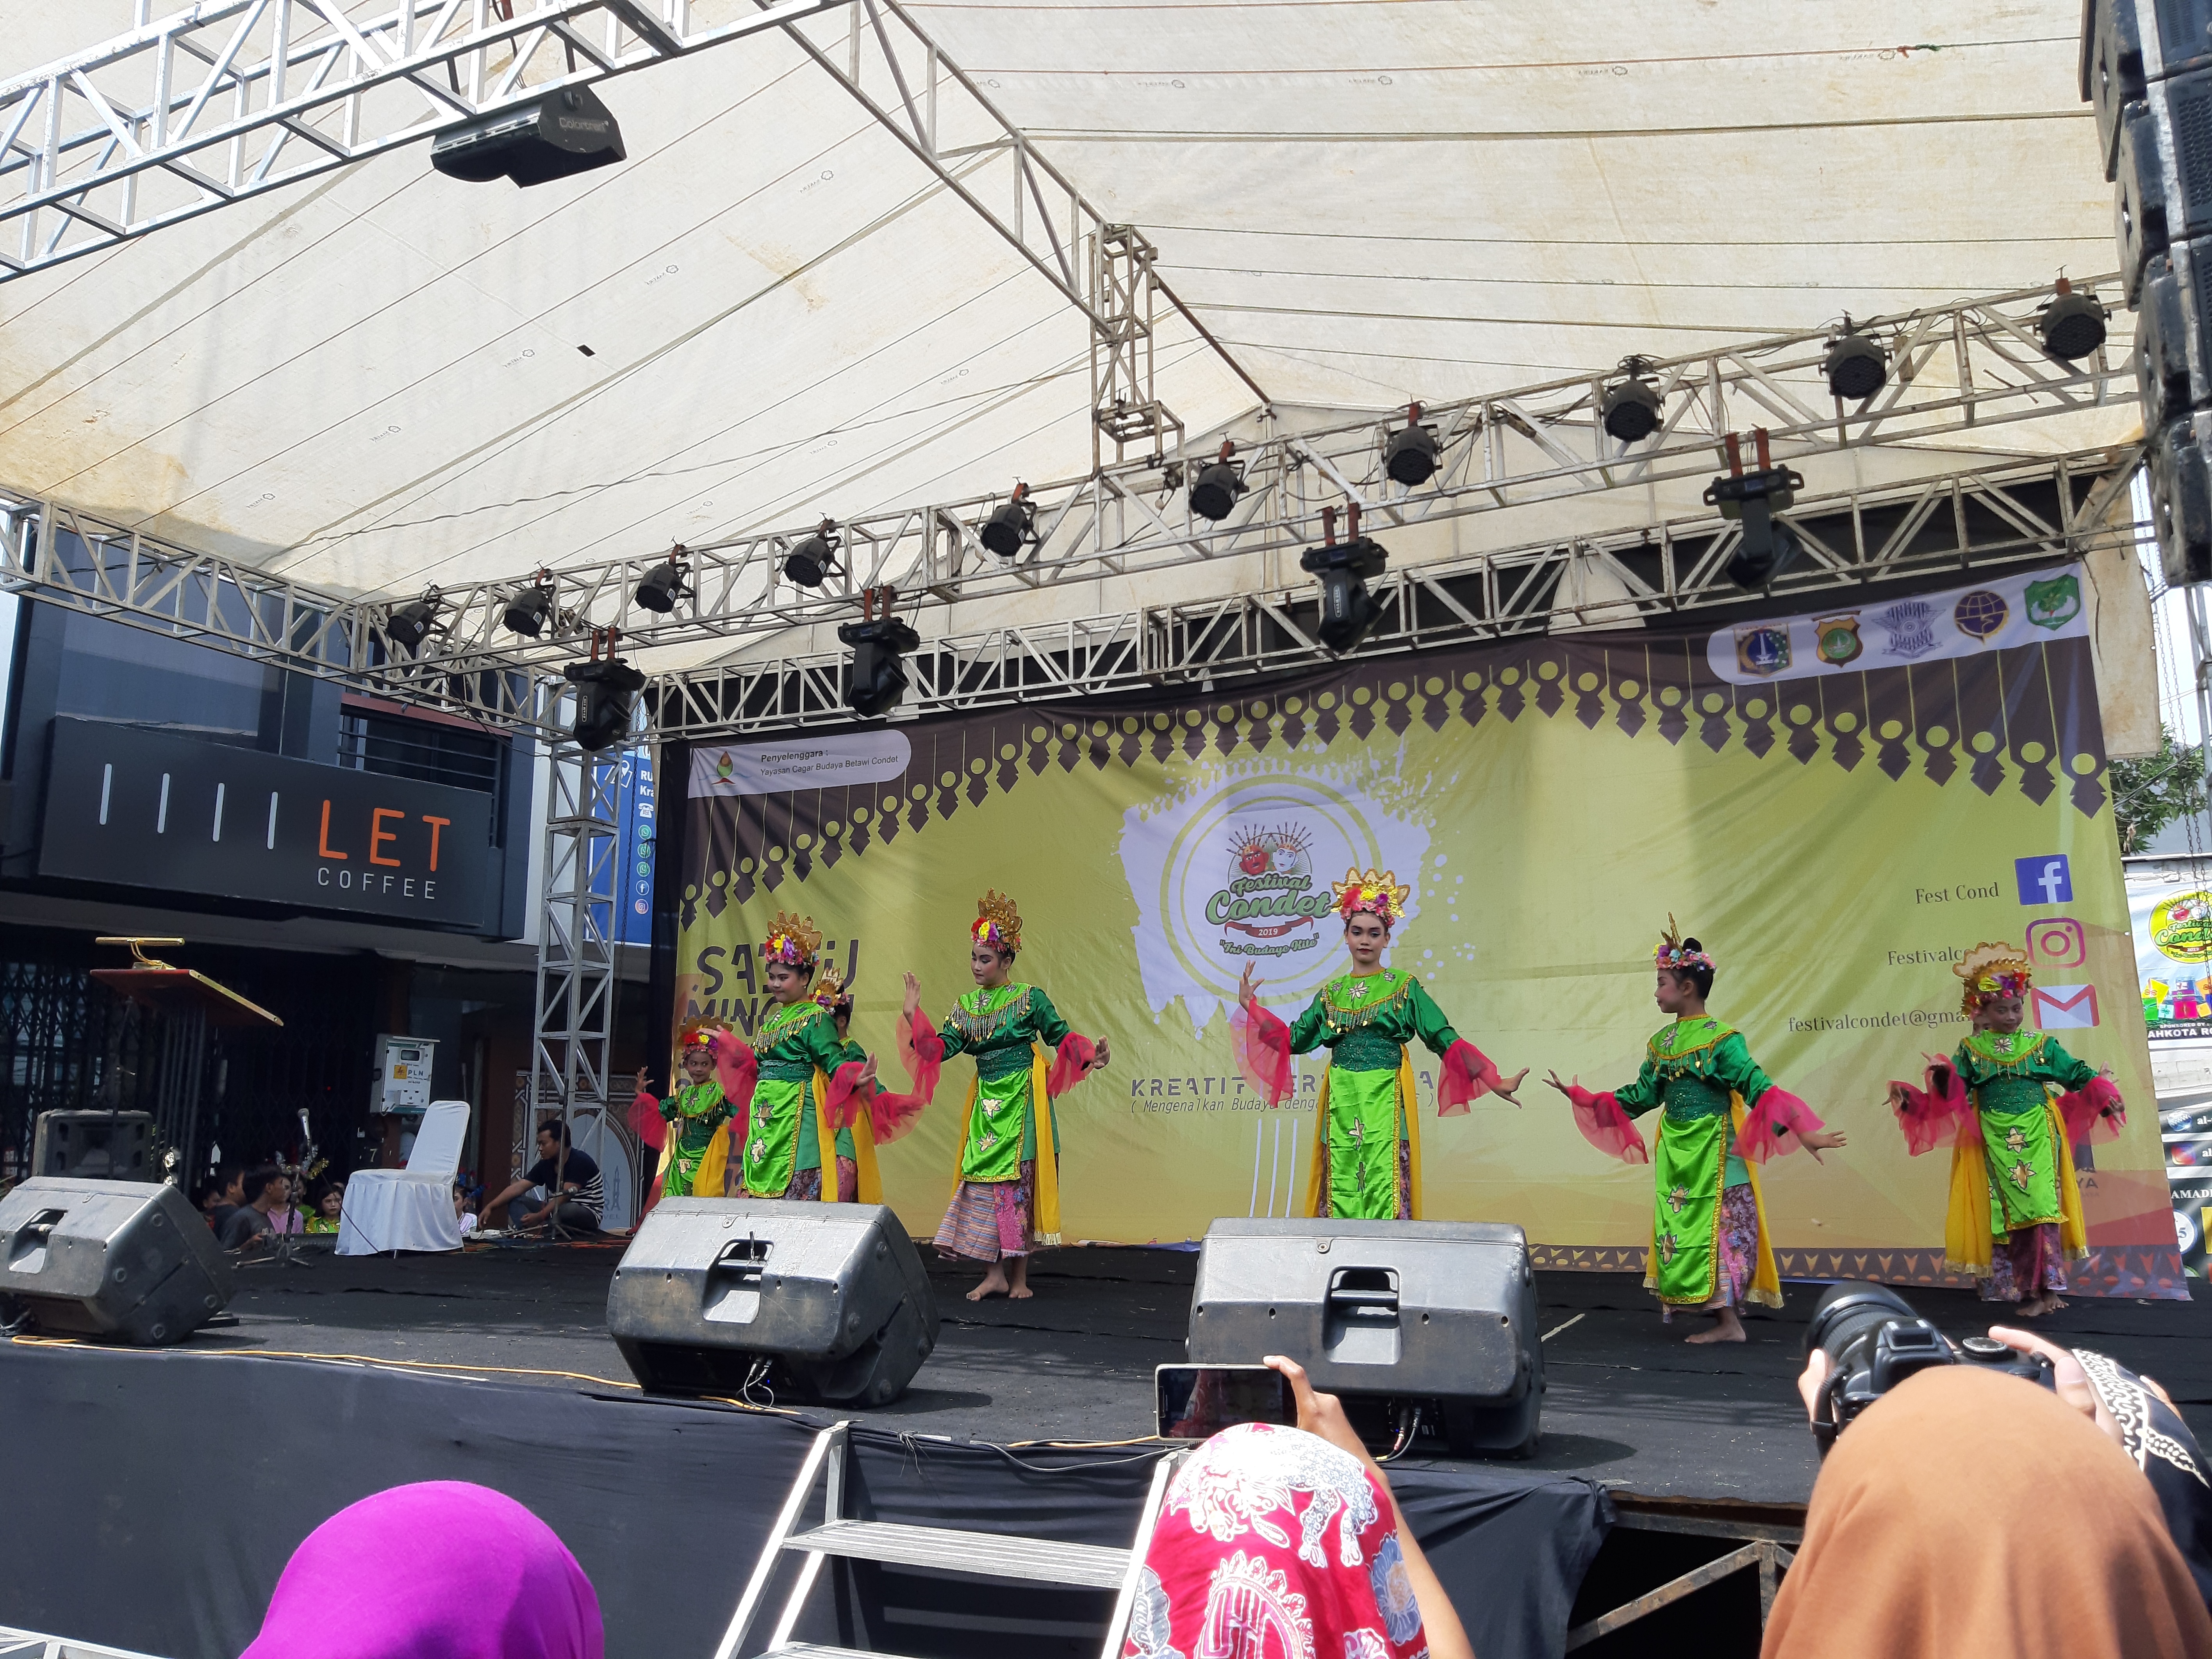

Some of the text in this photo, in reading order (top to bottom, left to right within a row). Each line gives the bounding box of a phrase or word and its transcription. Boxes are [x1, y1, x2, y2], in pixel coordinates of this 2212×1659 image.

[760, 755, 898, 777] Yayasan Cagar Budaya Betawi Condet
[761, 749, 823, 763] Penyelenggara
[319, 799, 451, 872] LET
[318, 867, 436, 899] COFFEE
[1230, 872, 1313, 897] Festival
[1915, 881, 2000, 904] Fest Cond
[1205, 888, 1333, 925] Condet
[1258, 928, 1279, 937] 2019
[1131, 1076, 1247, 1097] KREATIF
[1143, 1098, 1224, 1114] Mengenalkan
[1284, 1097, 1318, 1111] deng
